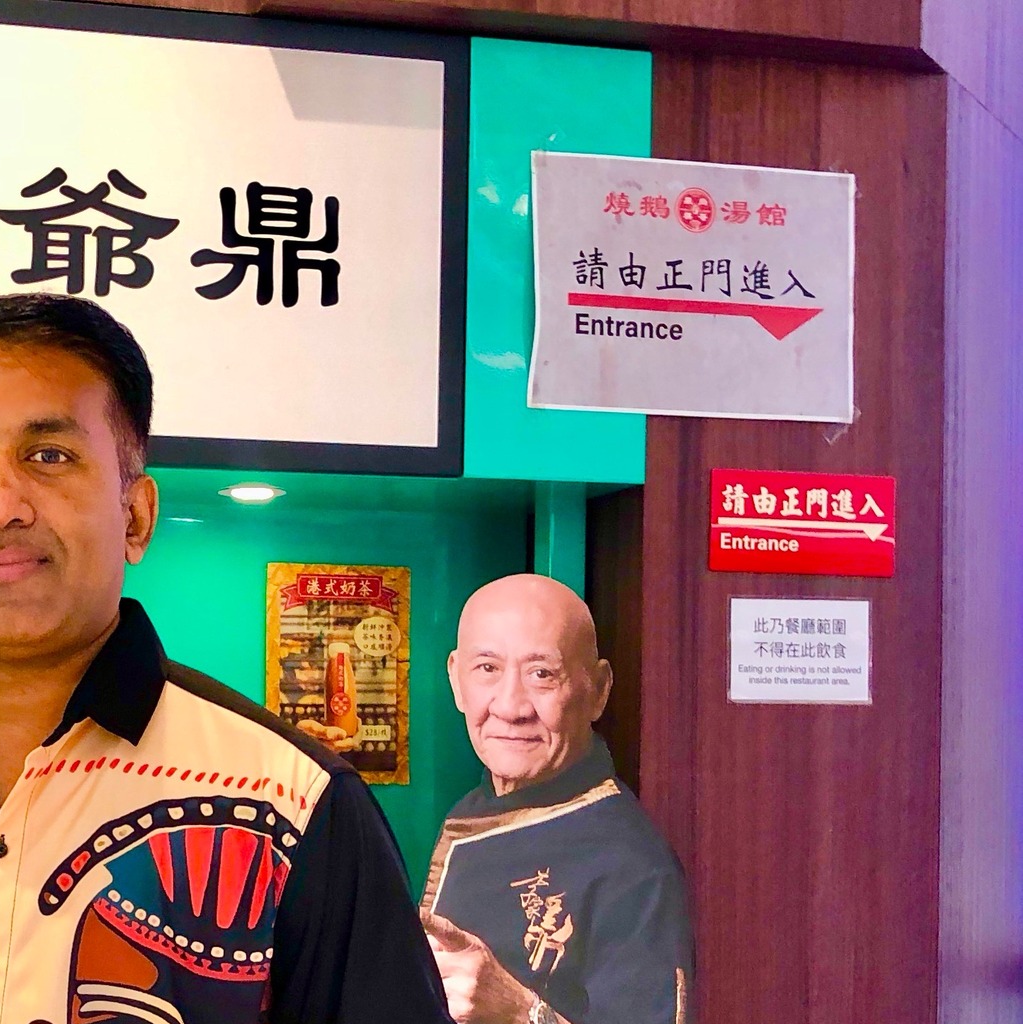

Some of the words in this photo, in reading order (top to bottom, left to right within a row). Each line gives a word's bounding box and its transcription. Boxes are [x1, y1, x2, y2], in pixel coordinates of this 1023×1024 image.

[603, 191, 670, 220] 燒鵝
[721, 201, 787, 227] 湯館
[573, 247, 816, 300] 請由正門進入
[575, 313, 683, 340] Entrance
[722, 484, 885, 520] 請由正門進入
[720, 532, 799, 552] Entrance
[306, 577, 373, 597] 港式奶茶
[753, 617, 847, 635] 此乃餐廳範圍
[753, 641, 847, 659] 不得在此飲食
[738, 664, 763, 674] Eating
[775, 665, 807, 675] drinking
[808, 666, 815, 674] is
[817, 666, 830, 674] not
[831, 666, 862, 674] allowed
[748, 676, 772, 684] inside
[774, 676, 788, 685] this
[790, 677, 829, 685] restaurant
[831, 678, 850, 686] area.
